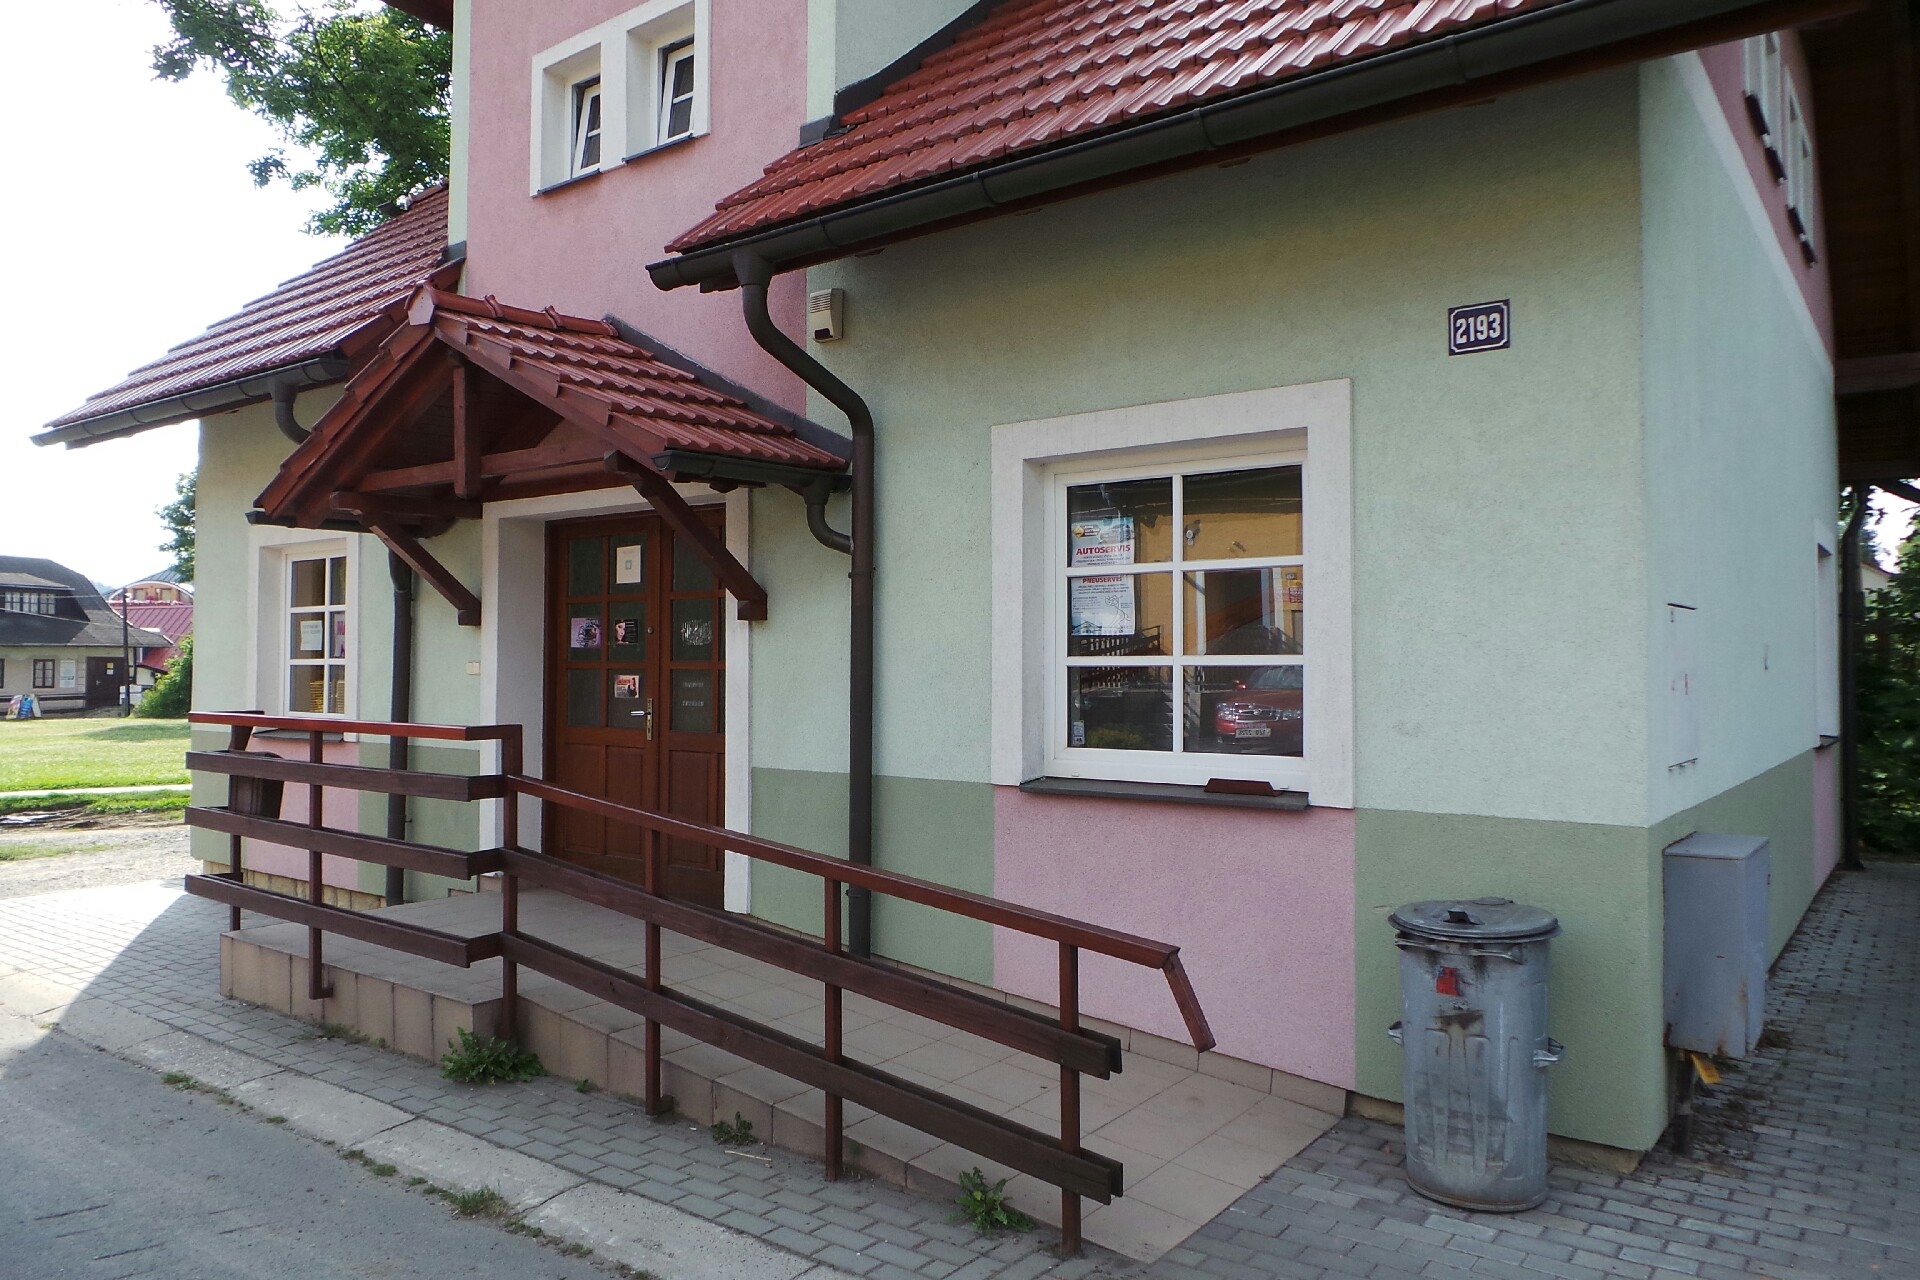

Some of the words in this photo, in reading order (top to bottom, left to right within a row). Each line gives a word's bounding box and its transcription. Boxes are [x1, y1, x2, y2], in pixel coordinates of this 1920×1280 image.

[1456, 312, 1501, 344] 2193
[1076, 544, 1131, 555] AUTOSERVIS
[1082, 576, 1123, 584] PNEUSERVIS
